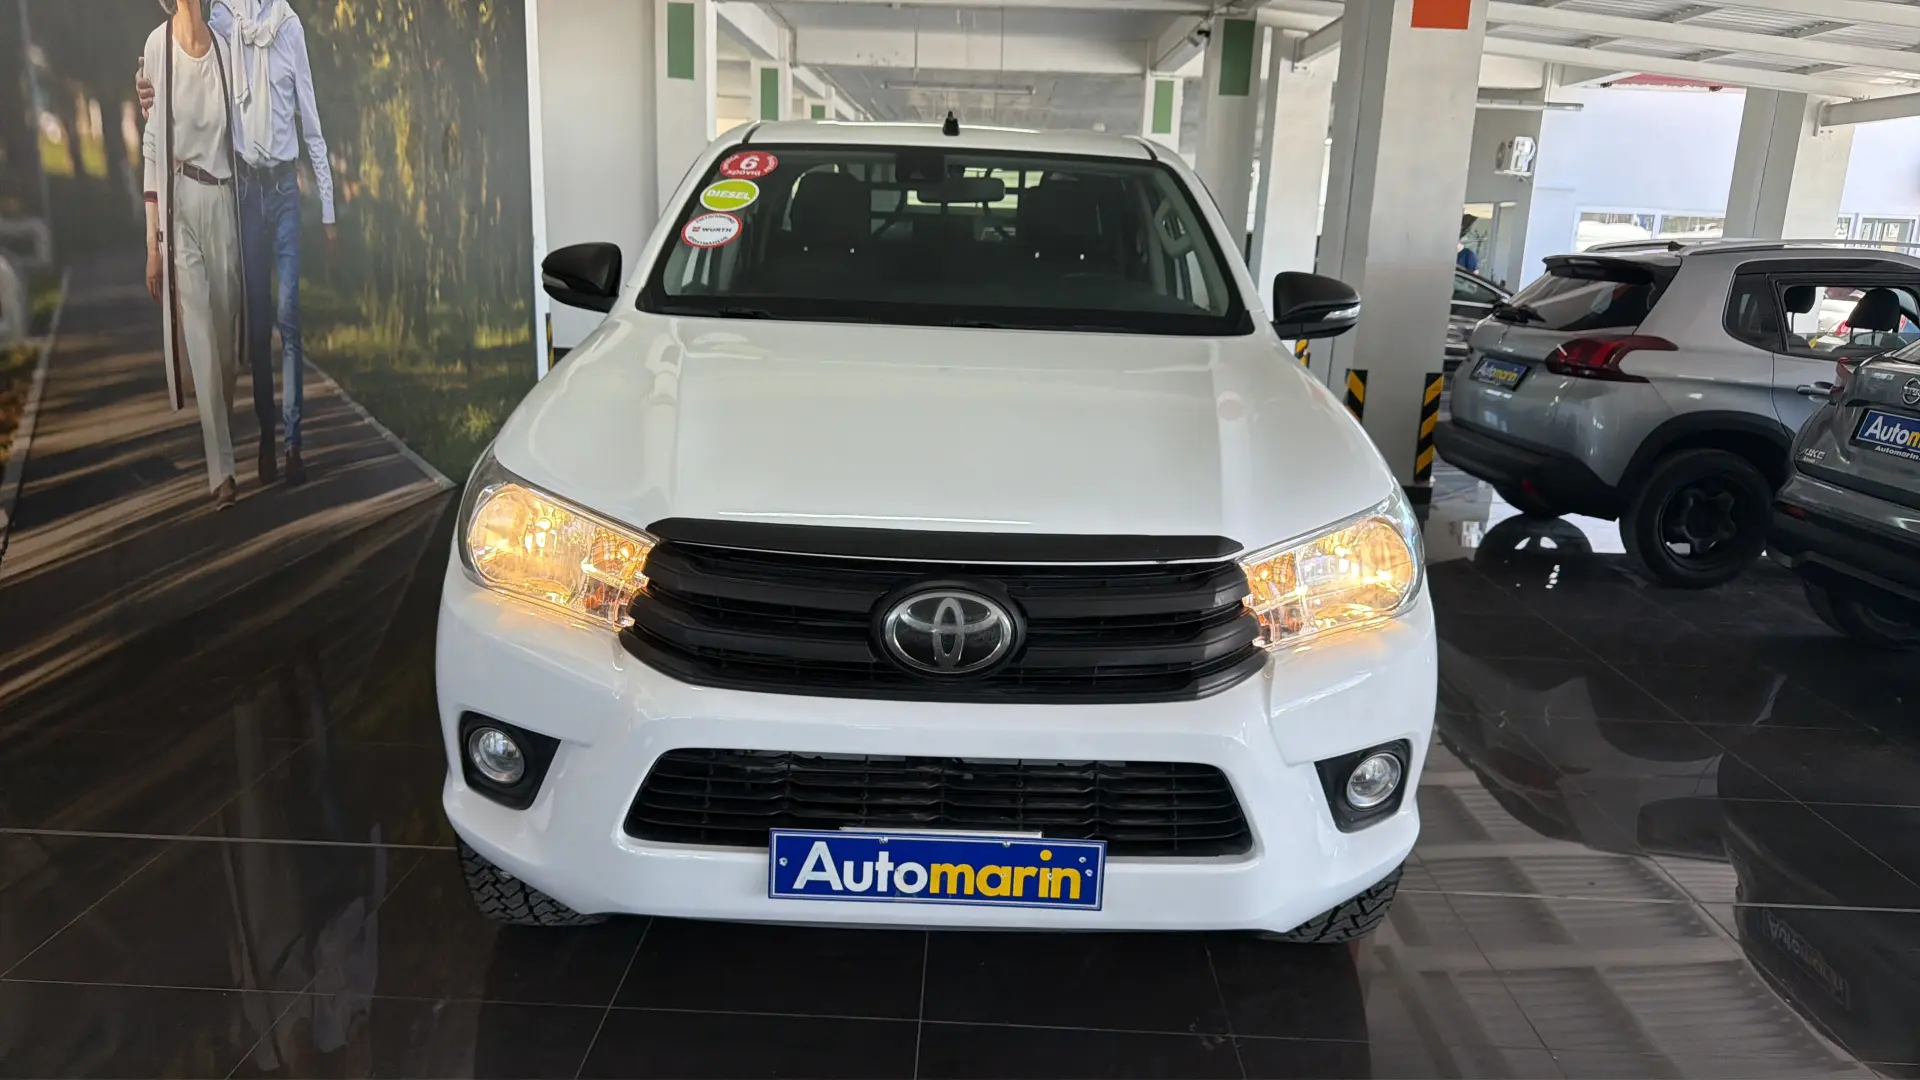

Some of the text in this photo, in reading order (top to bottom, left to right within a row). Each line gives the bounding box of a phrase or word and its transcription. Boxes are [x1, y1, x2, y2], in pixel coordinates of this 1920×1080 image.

[740, 155, 760, 170] 6
[705, 189, 751, 200] DIESEL
[792, 841, 1081, 900] Automarin
